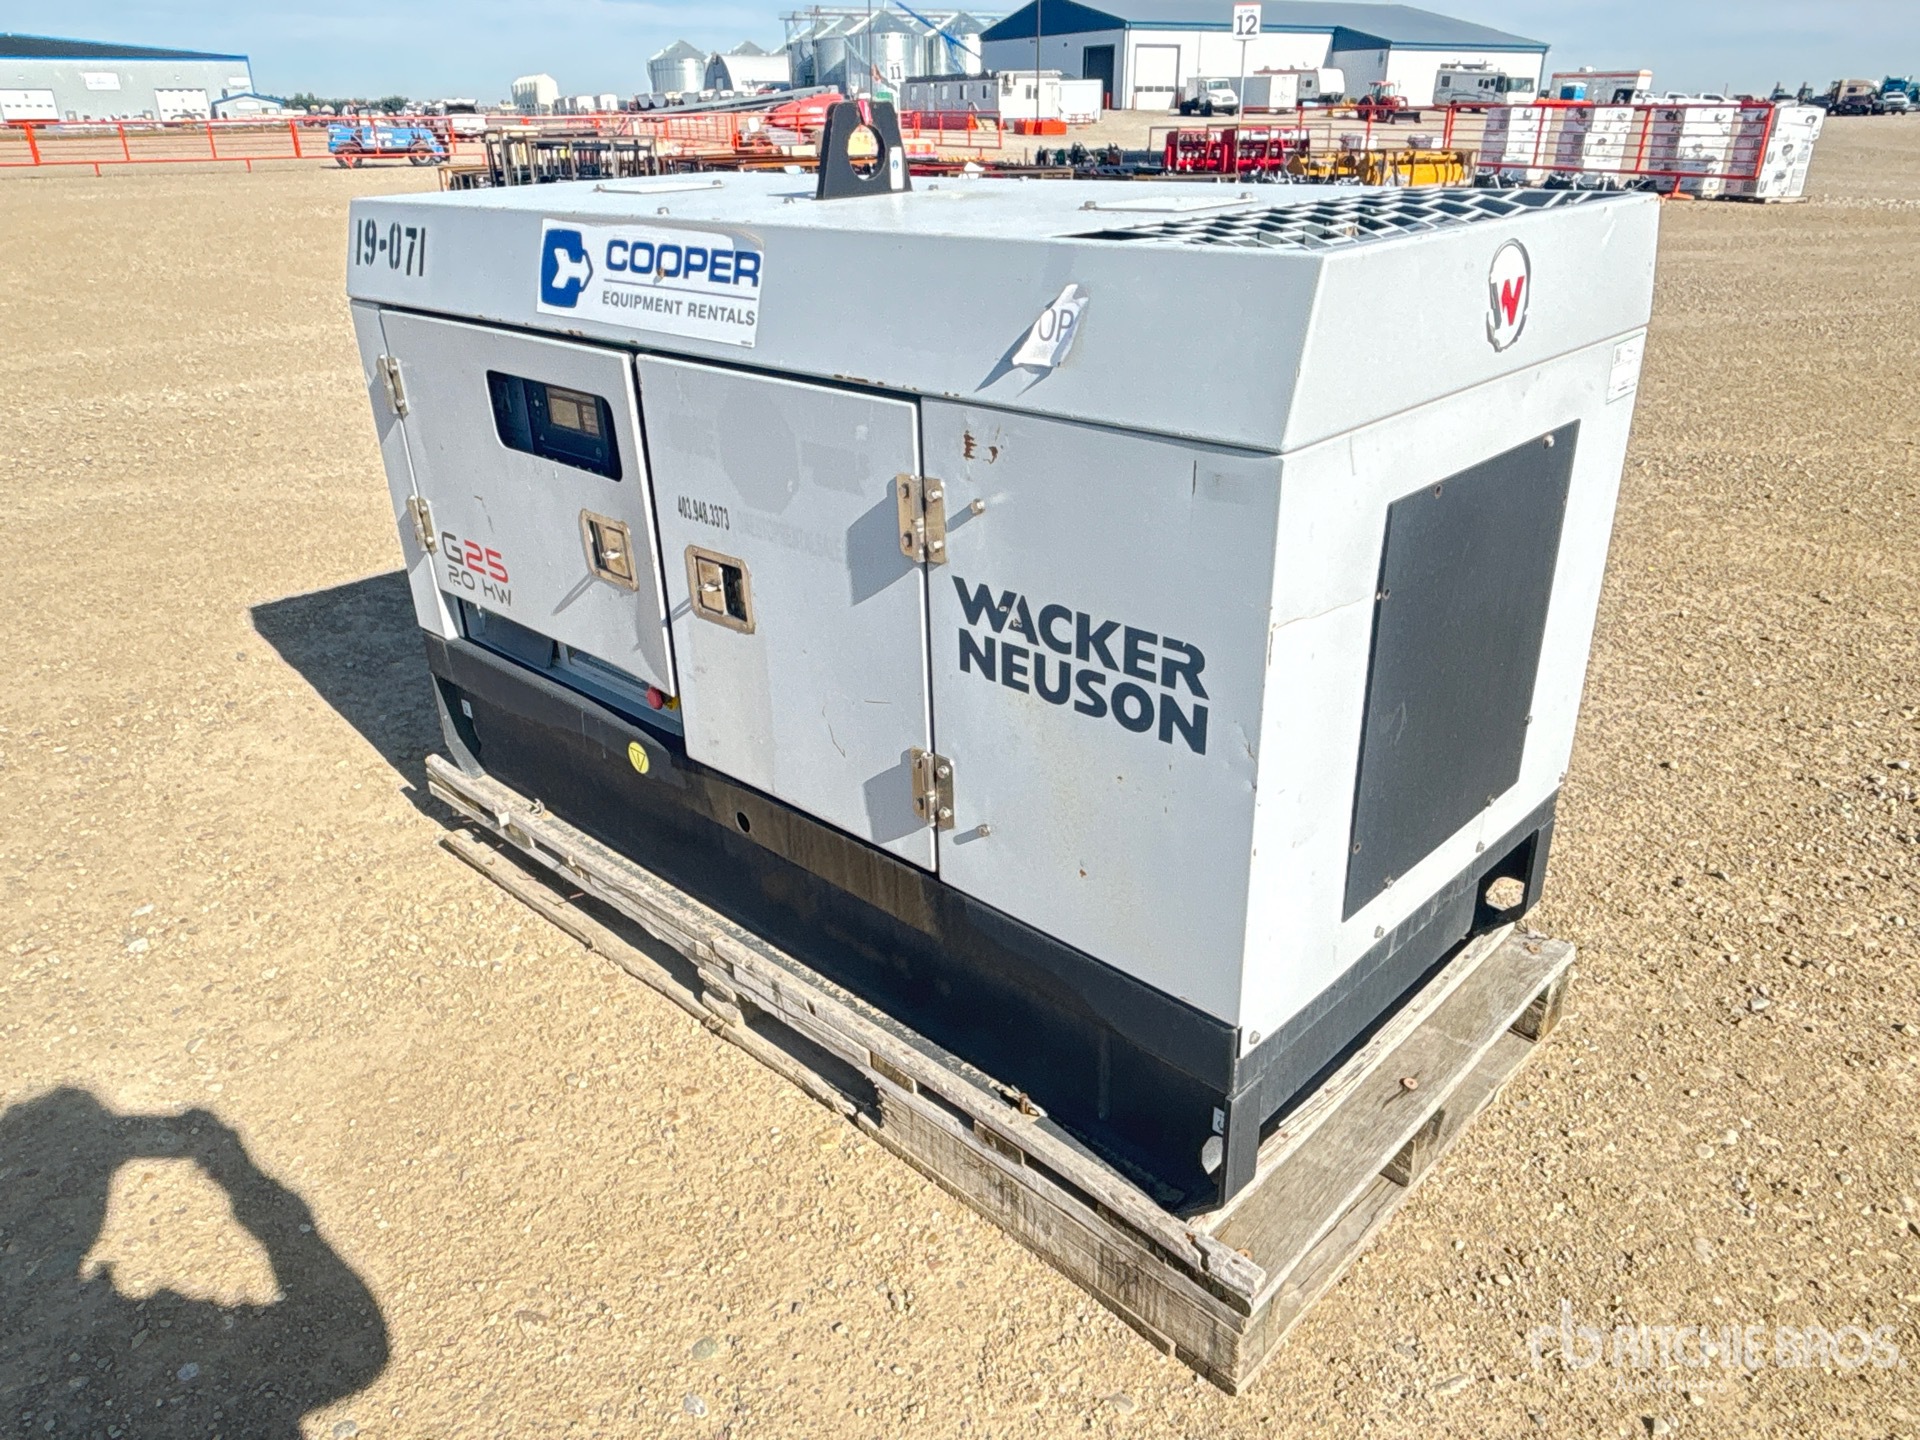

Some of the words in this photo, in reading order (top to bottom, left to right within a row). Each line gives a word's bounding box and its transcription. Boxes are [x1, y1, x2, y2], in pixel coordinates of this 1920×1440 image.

[1236, 14, 1258, 36] 12
[890, 65, 902, 80] 11
[355, 218, 426, 277] 19-071
[605, 239, 762, 288] COOPER
[602, 290, 683, 316] EQUIPMENT
[687, 301, 756, 327] RENTALS
[677, 494, 731, 531] 403.948.3373
[441, 530, 509, 584] G25
[447, 563, 476, 591] 20
[951, 574, 1210, 701] WACKER
[958, 627, 1209, 756] NEUSON
